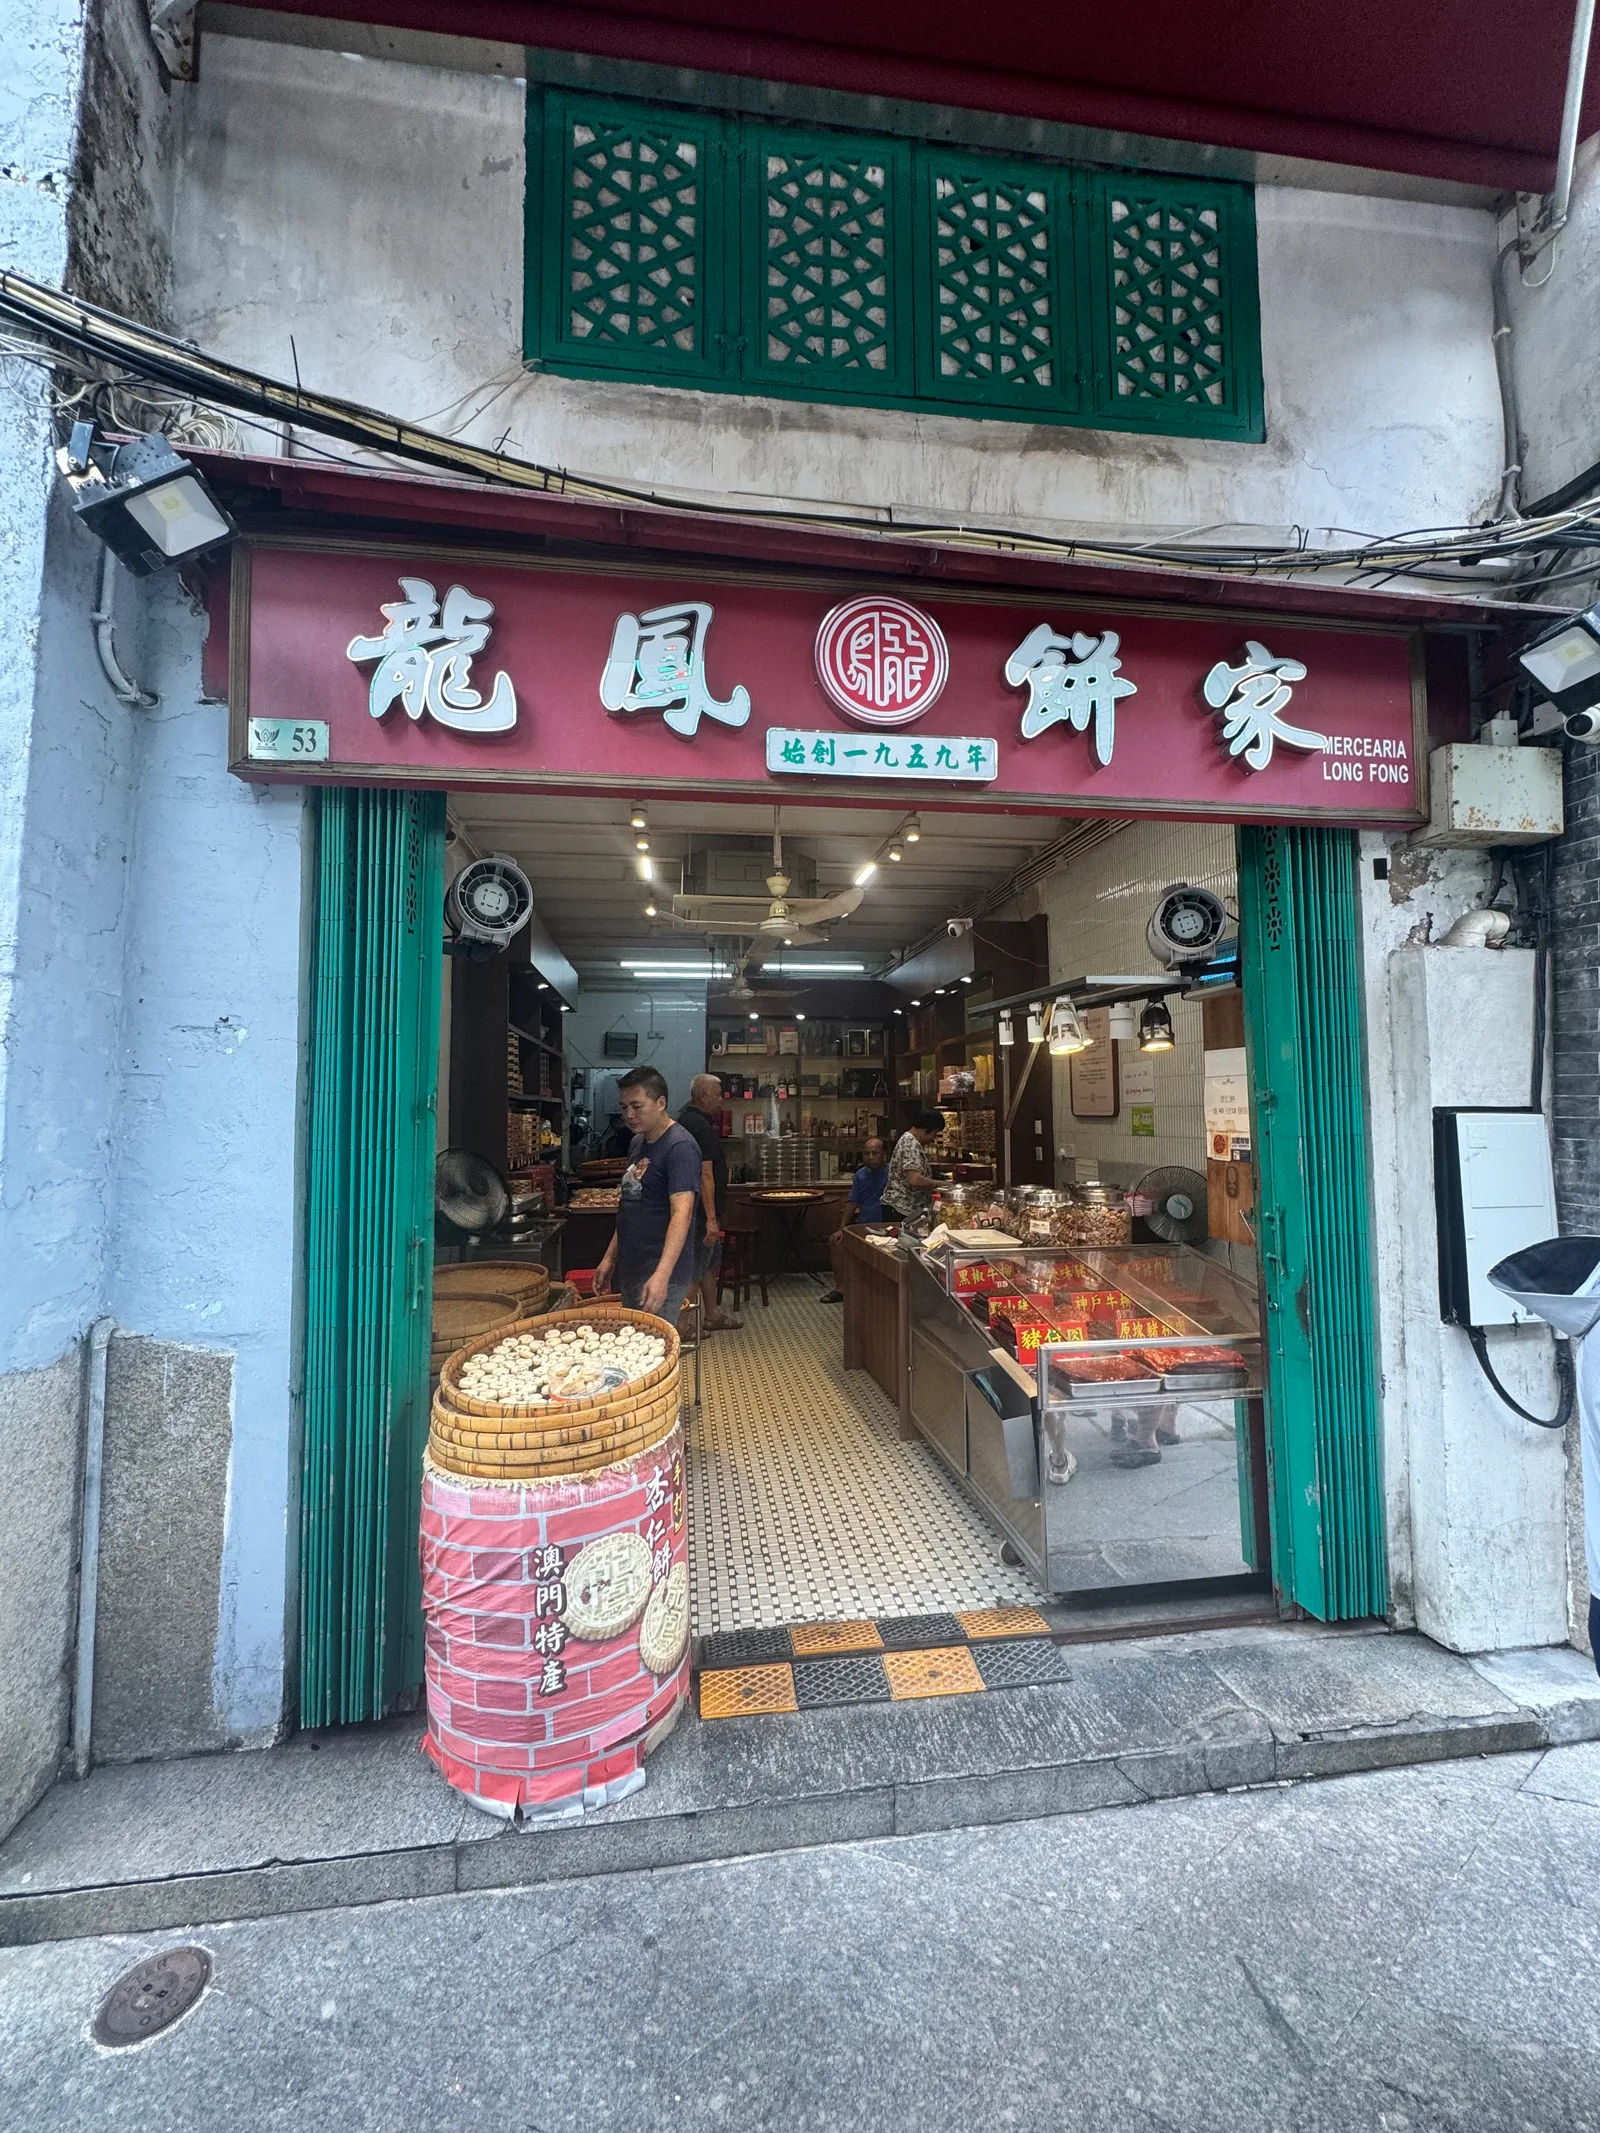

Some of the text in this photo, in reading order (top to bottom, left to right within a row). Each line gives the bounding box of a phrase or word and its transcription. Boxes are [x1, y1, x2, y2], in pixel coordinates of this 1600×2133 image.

[292, 728, 317, 752] 53
[1323, 736, 1407, 758] MERCEARIA
[780, 738, 987, 772] 始創一九五九年
[1323, 761, 1409, 783] LONG FONG
[958, 1263, 1013, 1287] 黑椒牛柳
[645, 1465, 673, 1584] 杏仁餅
[534, 1546, 566, 1695] 澳門特產
